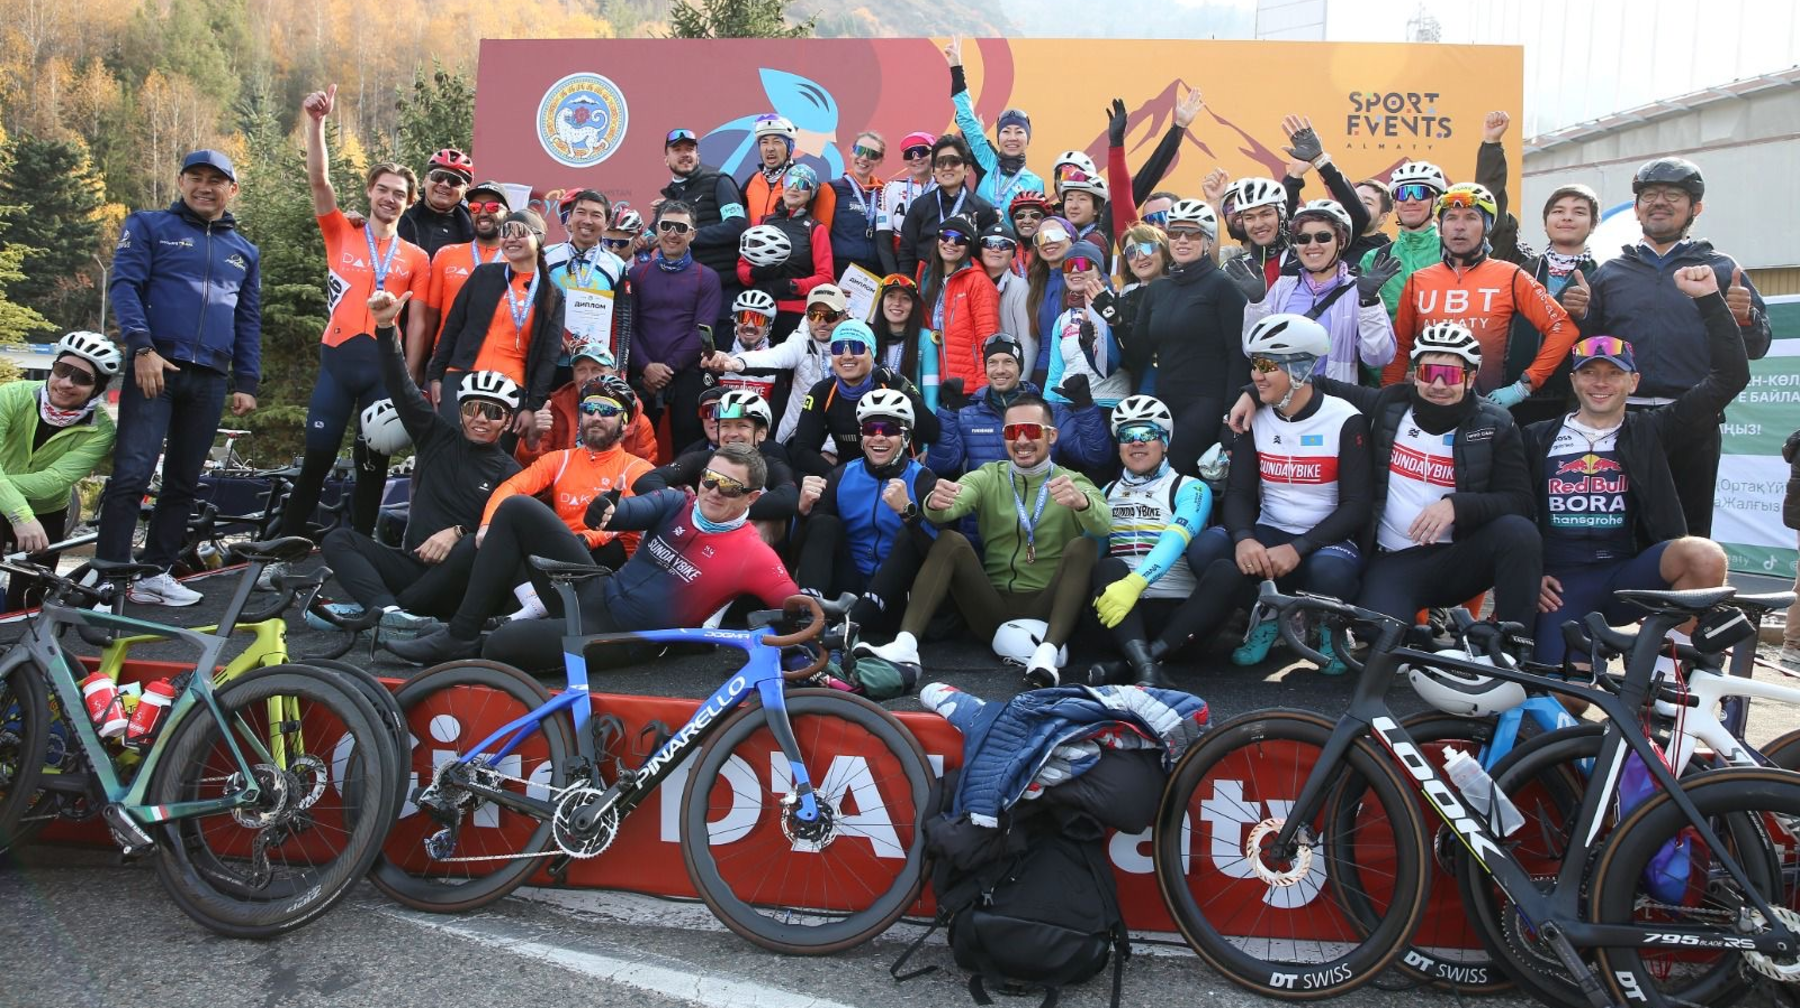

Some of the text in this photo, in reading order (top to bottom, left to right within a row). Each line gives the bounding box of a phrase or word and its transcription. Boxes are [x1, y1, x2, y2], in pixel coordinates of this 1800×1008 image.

[1349, 91, 1440, 113] SPORT
[1347, 114, 1452, 138] EVENTS
[328, 275, 342, 308] 26
[849, 276, 876, 294] ДИПЛОМ
[574, 300, 606, 310] ДИПЛОМ
[1418, 288, 1501, 315] UBT
[1750, 389, 1800, 403] БАЙЛА
[1260, 460, 1321, 478] SUNDAYBIKE
[1390, 450, 1455, 480] SUNDAYBIK
[1548, 476, 1590, 494] Red
[1548, 495, 1626, 512] BORA
[1553, 513, 1623, 526] hansgrohe
[704, 631, 750, 640] DOGMA
[636, 675, 746, 790] PINARELLO
[1372, 716, 1505, 861] LOOK
[1643, 933, 1700, 945] 795
[1722, 937, 1756, 949] RS
[1269, 962, 1352, 989] DT SWISS
[1403, 950, 1488, 984] DT SWISS
[1614, 970, 1648, 1002] DT
